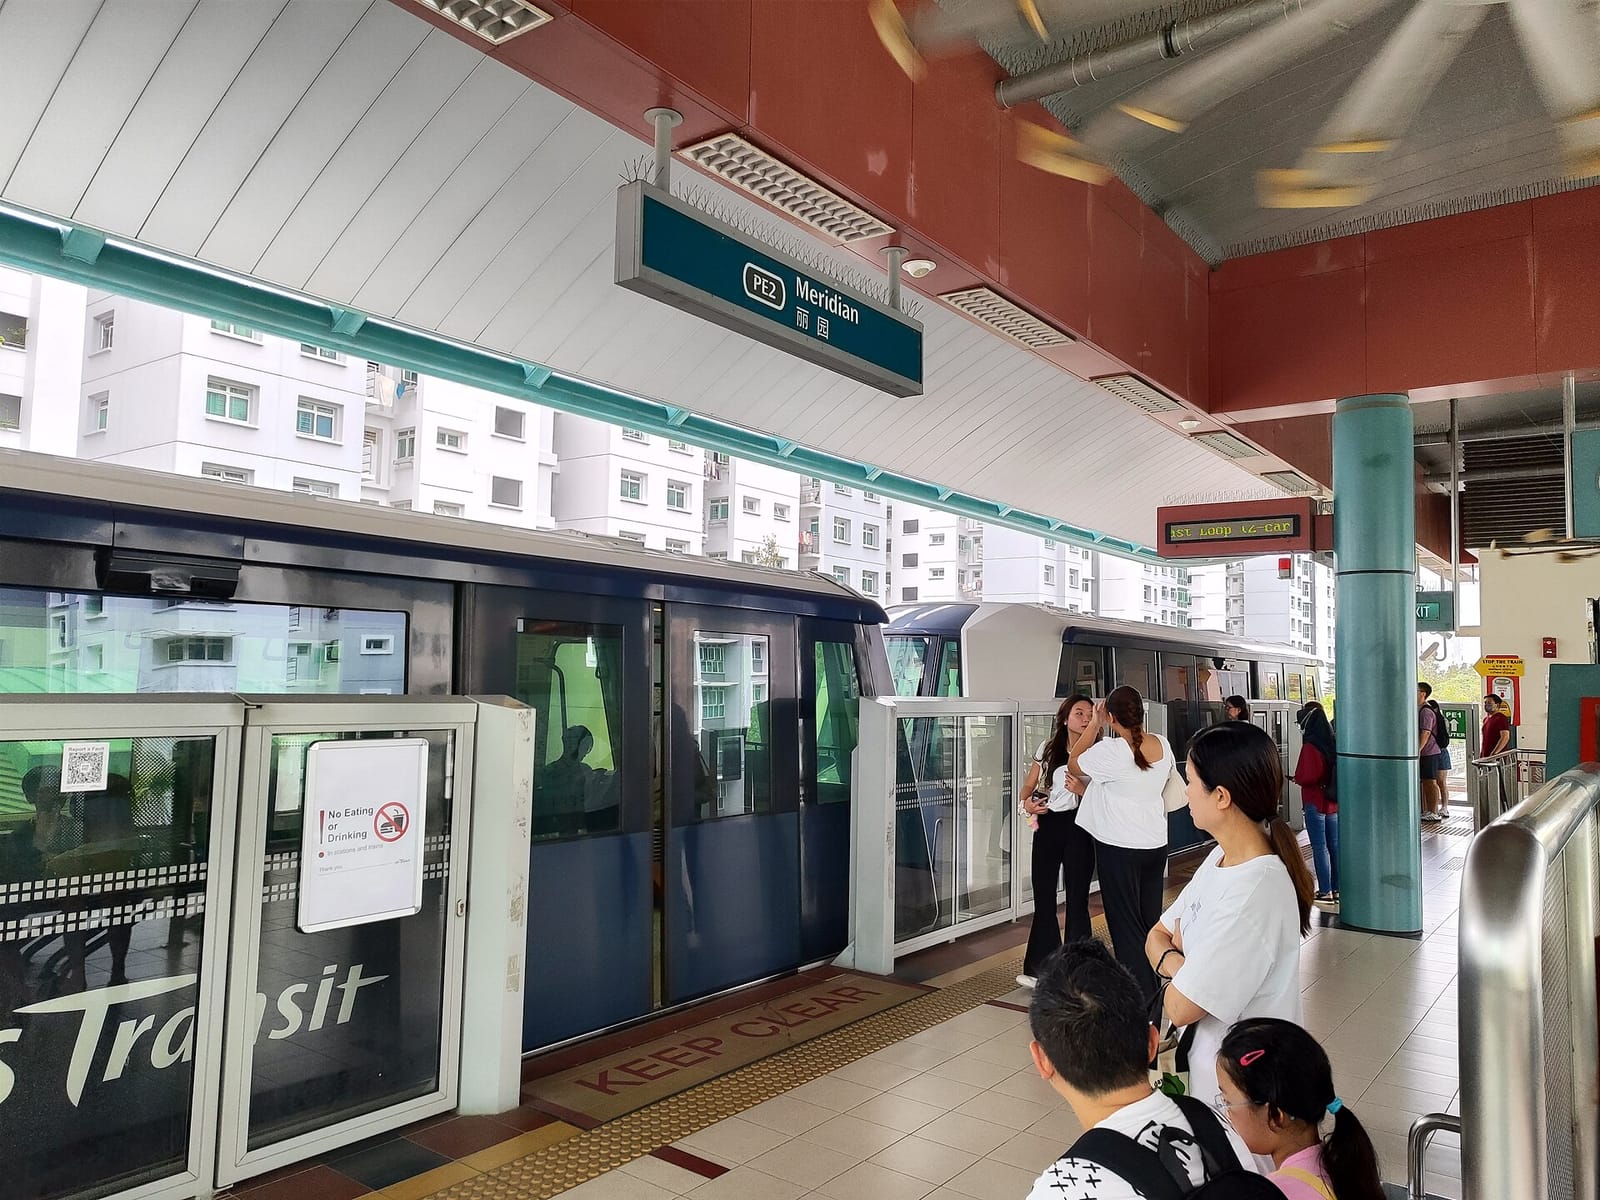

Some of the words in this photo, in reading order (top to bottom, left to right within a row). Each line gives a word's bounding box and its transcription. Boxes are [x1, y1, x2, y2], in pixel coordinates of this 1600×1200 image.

[753, 274, 776, 299] PE2
[796, 276, 859, 324] Meridian
[796, 306, 829, 340] 丽园
[328, 810, 342, 819] No
[344, 807, 374, 817] Eating
[328, 823, 338, 831] or
[327, 831, 368, 843] Drinking
[334, 847, 356, 856] stations
[573, 1036, 724, 1096] KEEP
[730, 986, 882, 1038] CLEAR
